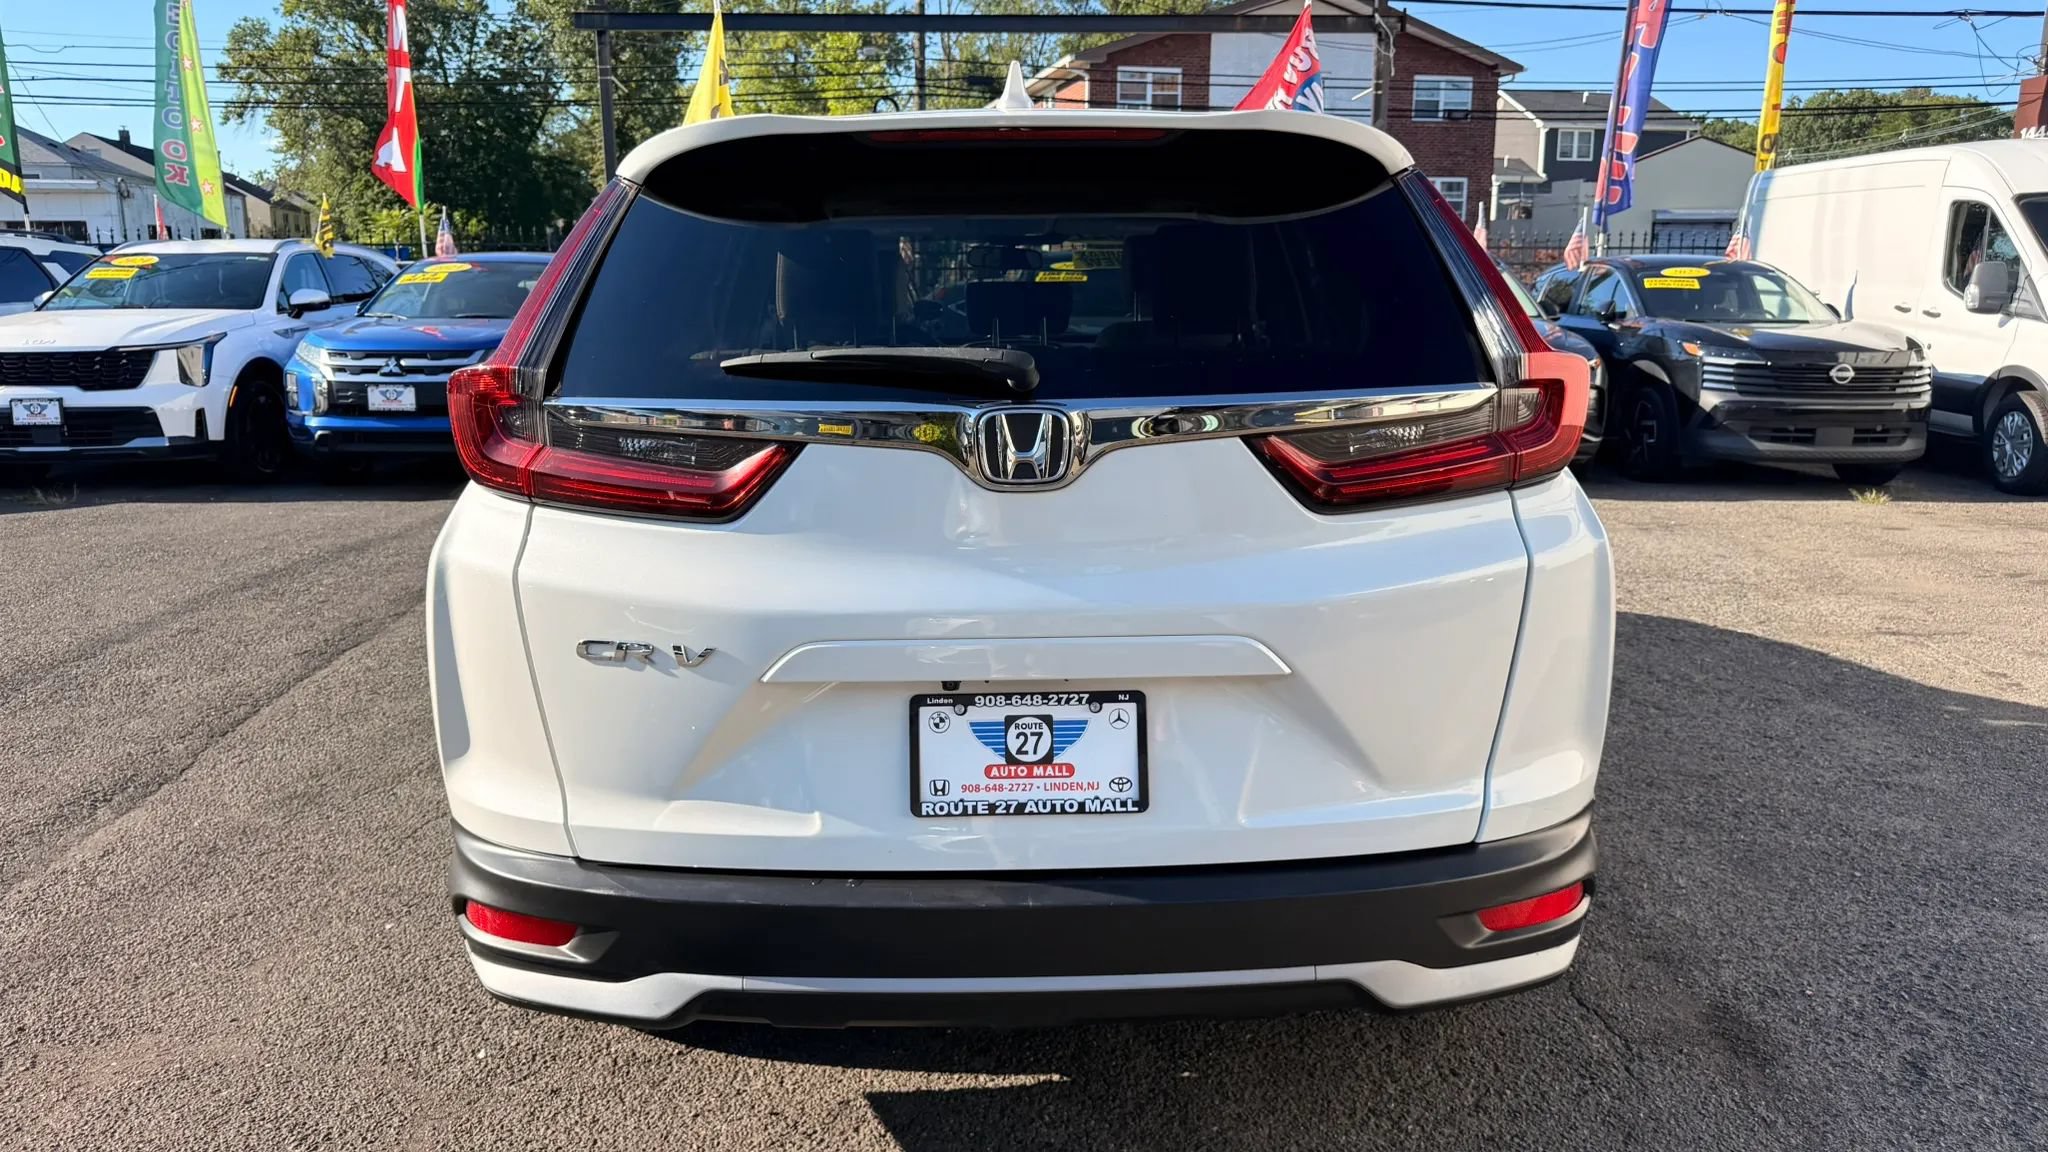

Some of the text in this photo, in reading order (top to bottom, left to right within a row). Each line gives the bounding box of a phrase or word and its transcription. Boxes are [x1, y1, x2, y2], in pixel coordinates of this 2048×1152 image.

[974, 693, 1090, 707] 908-648-2727
[1014, 722, 1044, 731] ROUTE
[1015, 731, 1044, 756] 27
[990, 765, 1070, 777] AUTO MALL
[960, 783, 1034, 793] 908-648-2727
[921, 798, 1139, 816] ROUTE 27 AUTO MALL
